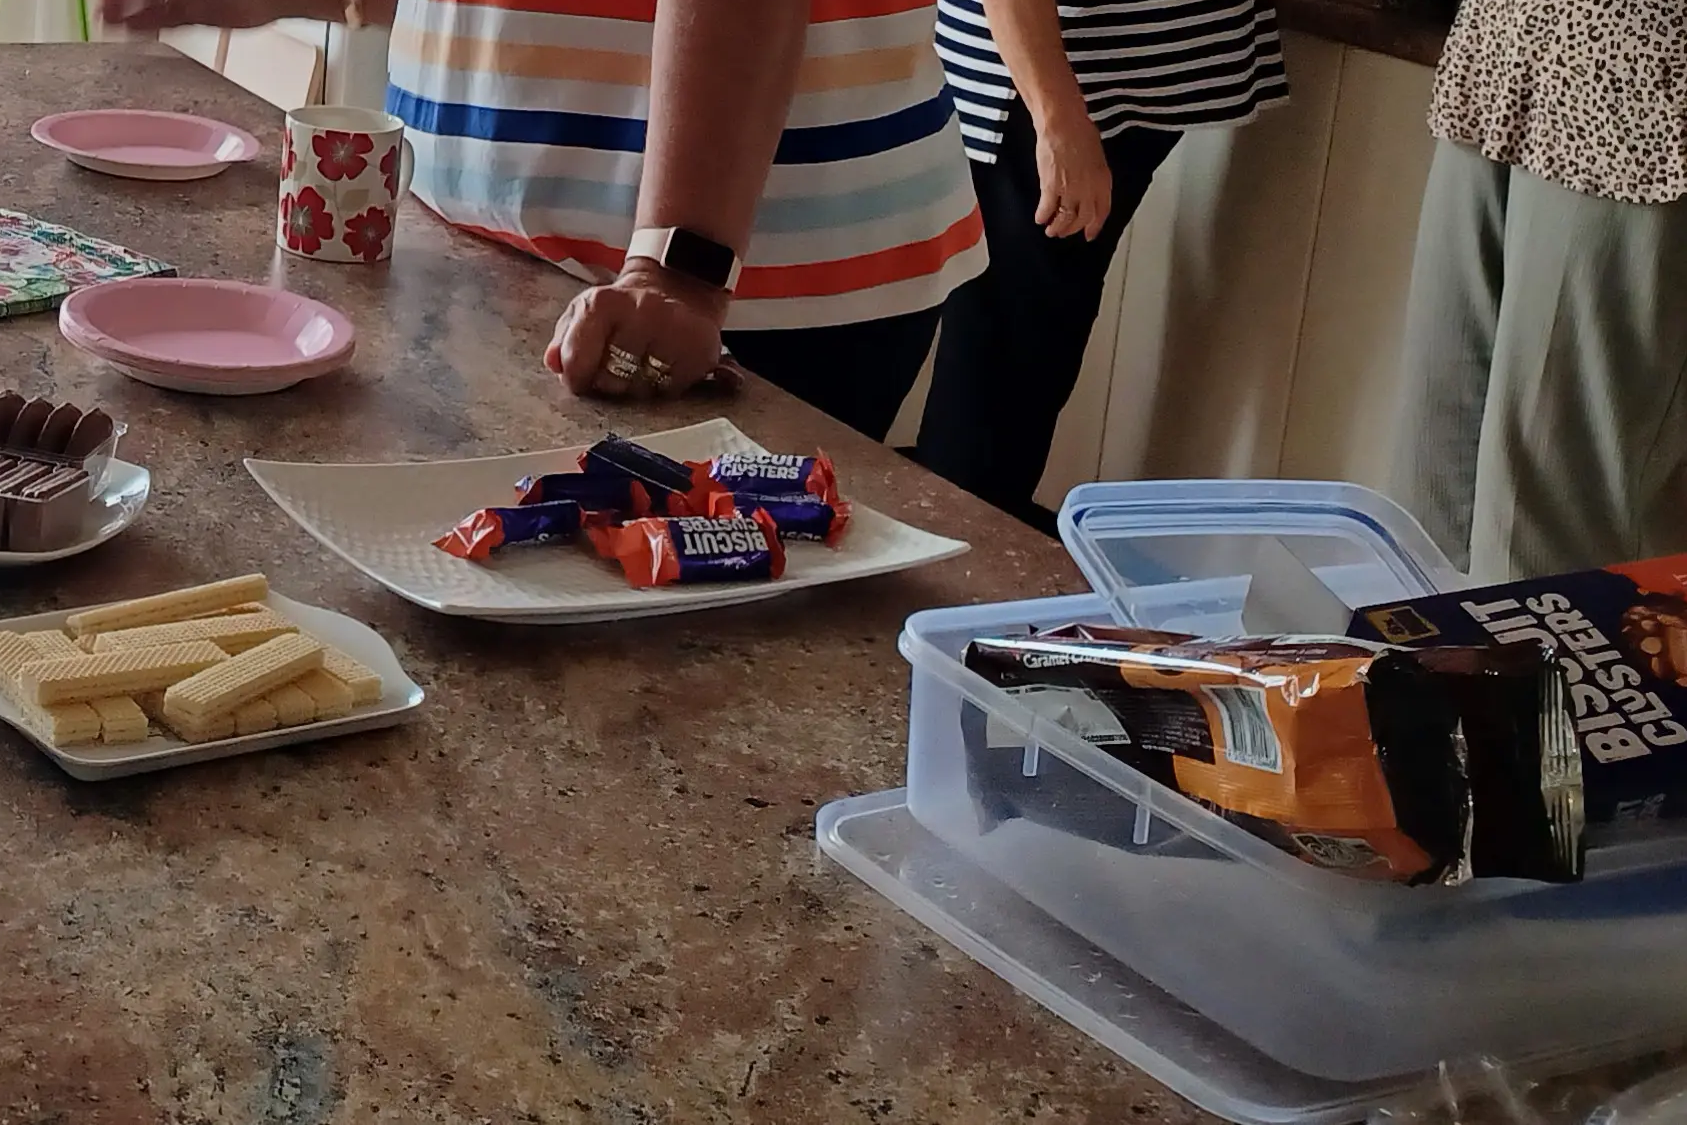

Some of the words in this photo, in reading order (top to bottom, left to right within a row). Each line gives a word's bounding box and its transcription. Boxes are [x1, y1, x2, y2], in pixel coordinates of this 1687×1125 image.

[720, 464, 800, 480] CLUSTERS
[684, 531, 769, 554] BISCUIT
[1526, 593, 1687, 746] CLUSTERS
